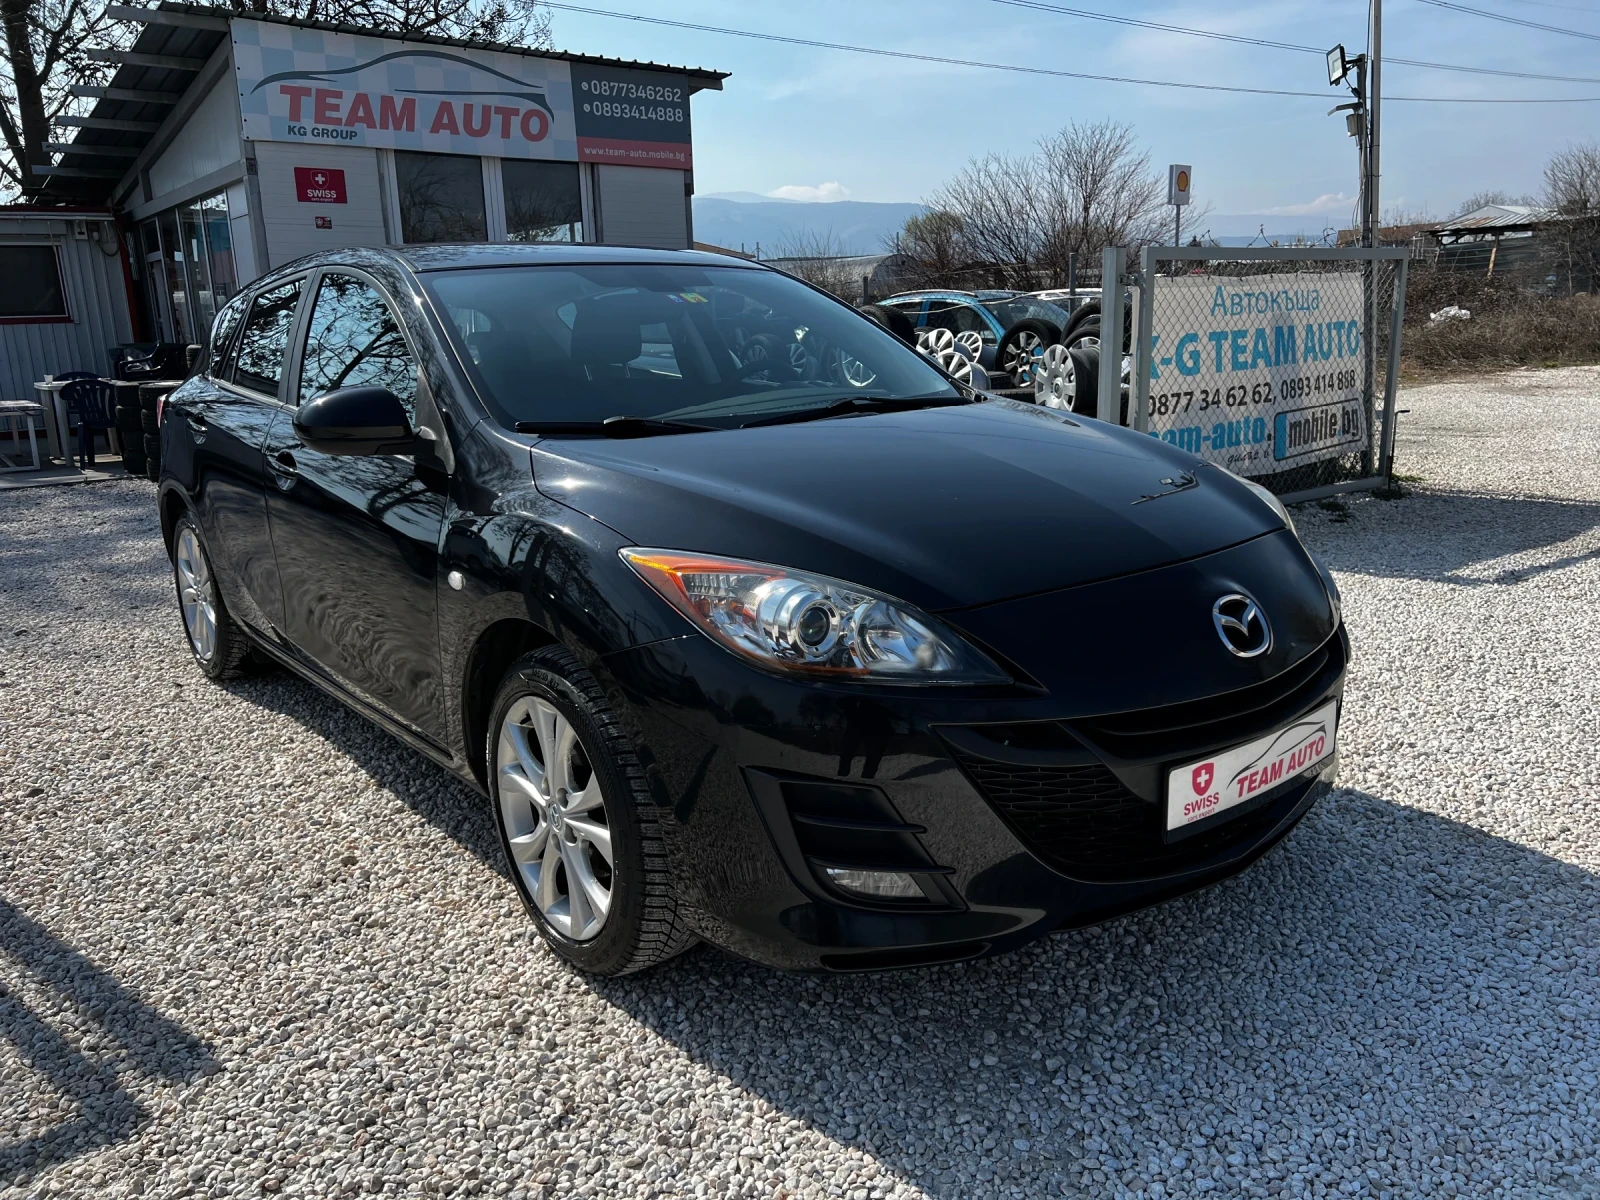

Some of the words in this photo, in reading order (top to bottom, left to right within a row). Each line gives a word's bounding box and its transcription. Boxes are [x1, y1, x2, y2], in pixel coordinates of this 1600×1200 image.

[590, 80, 682, 102] 0877346262
[280, 84, 416, 132] TEAM
[429, 101, 549, 142] AUTO
[592, 101, 684, 122] 0893414888
[288, 125, 307, 136] KG
[311, 127, 358, 140] GROUP
[583, 147, 685, 161] www.team-auto.mobile.bg
[307, 189, 337, 198] SWISS
[1210, 285, 1319, 316] Автокъща
[1208, 325, 1297, 374] TEAM
[1303, 319, 1360, 363] AUTO
[1199, 388, 1221, 411] 34
[1226, 385, 1247, 407] 62
[1281, 377, 1311, 400] 0893
[1314, 373, 1334, 394] 414
[1337, 369, 1355, 390] 888
[1288, 406, 1359, 448] mobile.bg
[1236, 758, 1284, 798] TEAM
[1286, 735, 1325, 774] AUTO
[1183, 792, 1220, 816] SWISS
